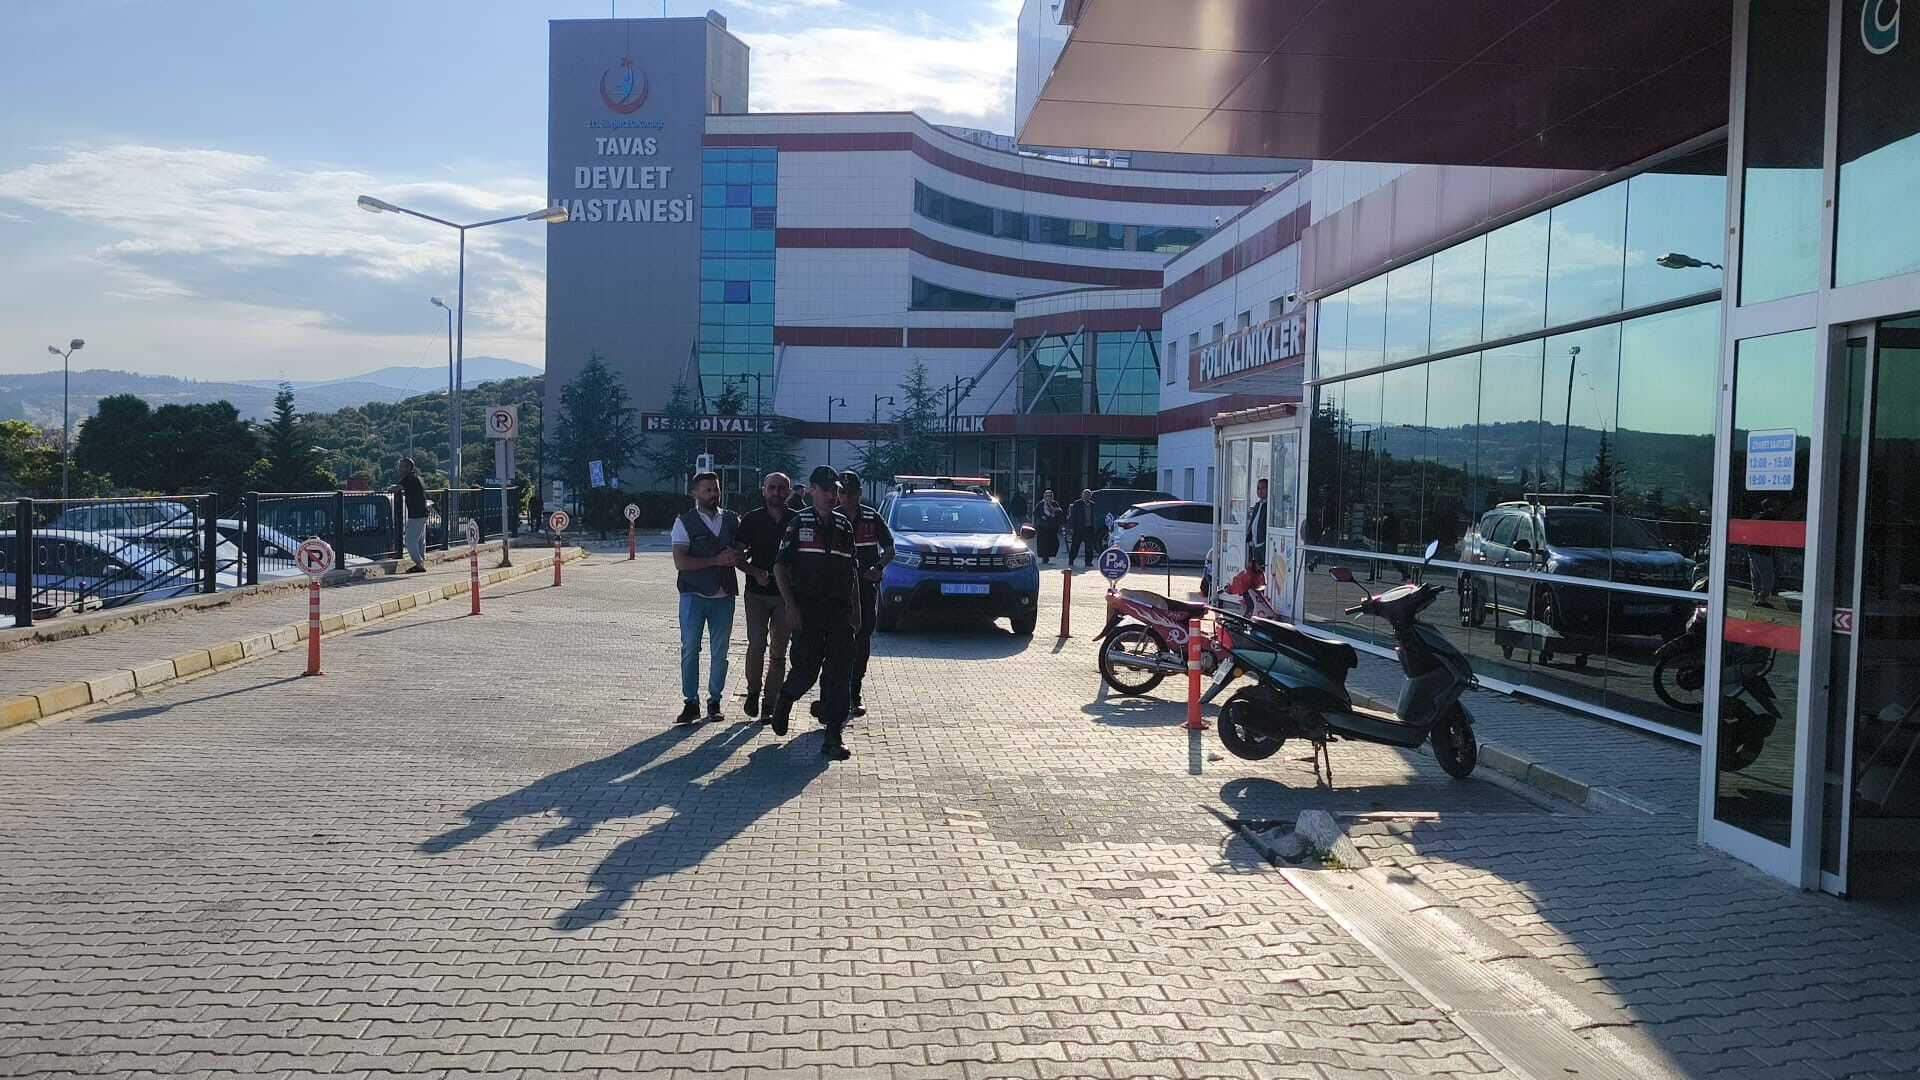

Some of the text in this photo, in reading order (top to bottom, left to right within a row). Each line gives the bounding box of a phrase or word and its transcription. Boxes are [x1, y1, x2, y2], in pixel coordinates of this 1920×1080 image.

[595, 136, 658, 156] TAVAS
[574, 166, 672, 190] DEVLET
[1750, 457, 1767, 468] 13:00
[1774, 456, 1792, 468] 15:00
[1749, 474, 1766, 486] 19:00
[1772, 474, 1792, 485] 21:00
